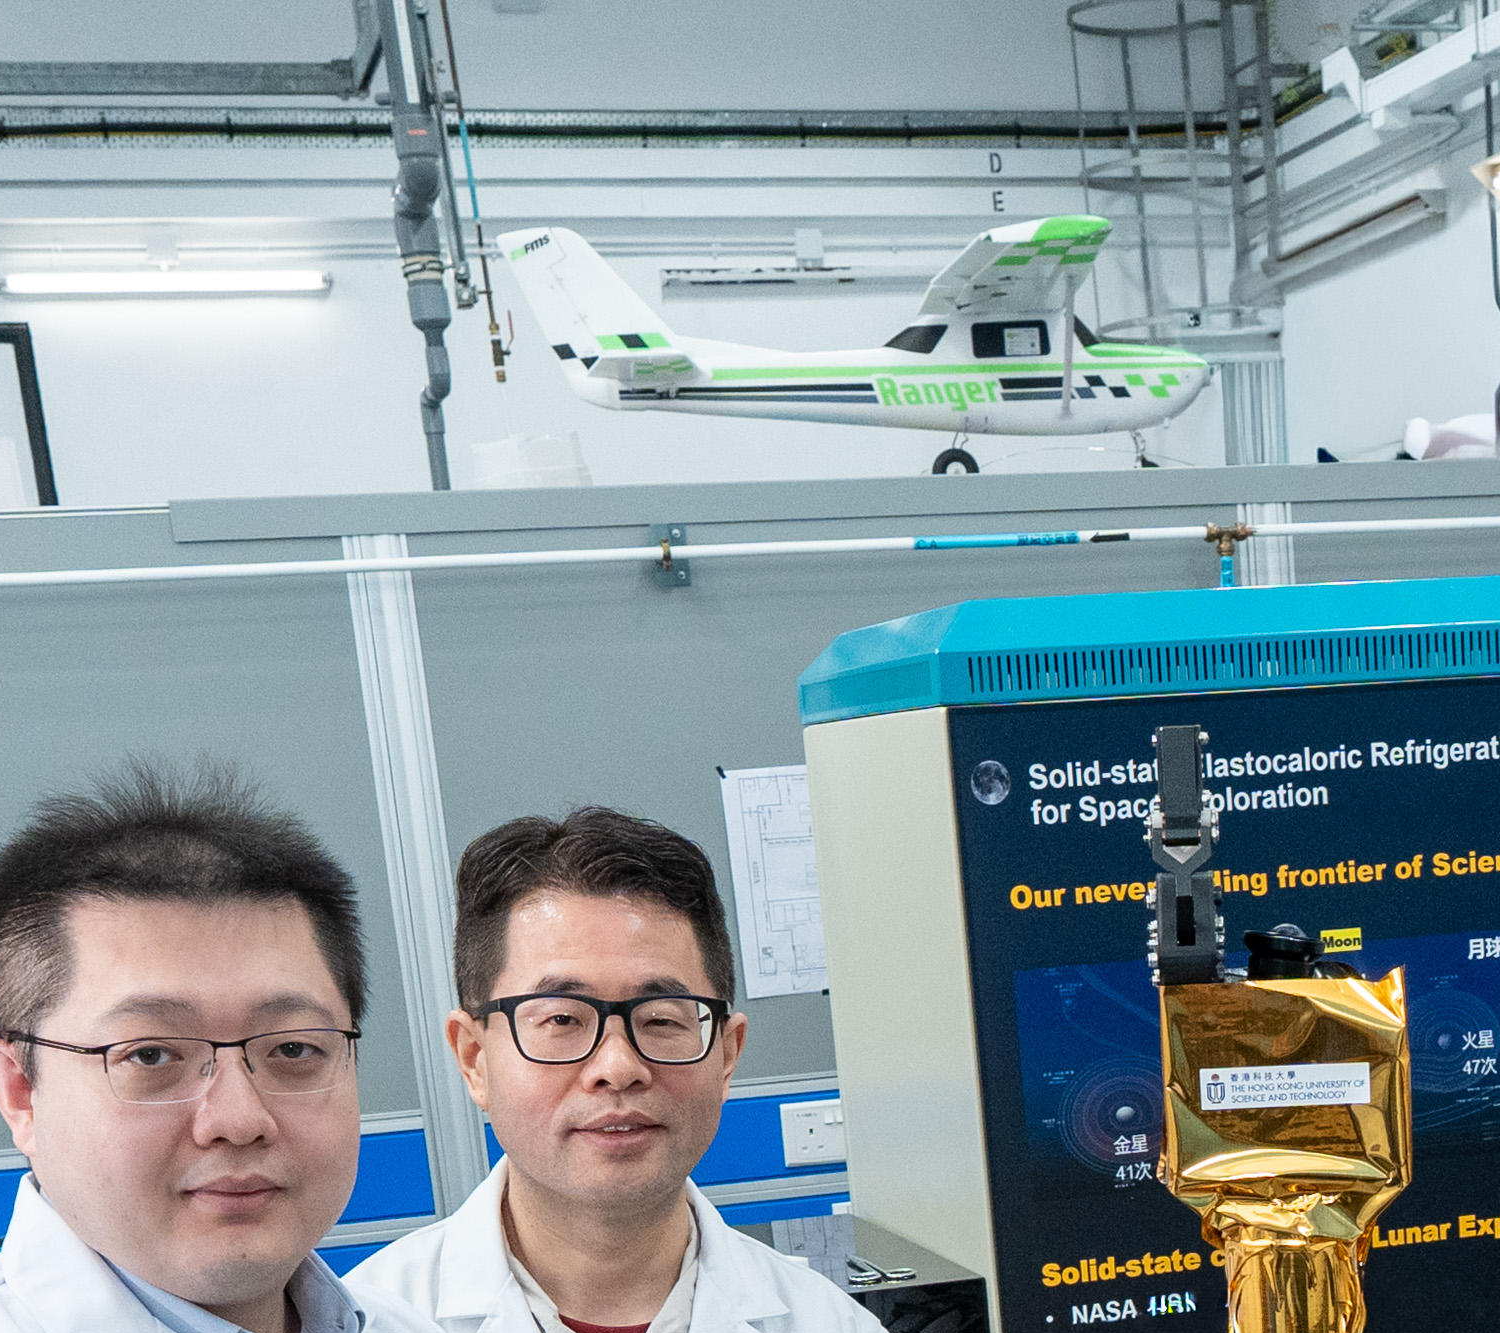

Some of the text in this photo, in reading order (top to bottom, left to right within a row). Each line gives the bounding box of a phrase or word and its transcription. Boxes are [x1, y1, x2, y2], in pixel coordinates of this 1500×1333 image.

[989, 152, 1002, 173] D
[992, 190, 1005, 212] E
[876, 377, 998, 411] Ranger
[1029, 757, 1158, 790] Solid-stat
[1201, 744, 1362, 779] lastocaloric
[1030, 800, 1071, 825] for
[1010, 885, 1066, 909] Our
[1277, 858, 1386, 888] frontier
[1395, 854, 1422, 879] of
[1322, 936, 1362, 948] Moon
[1462, 1030, 1494, 1050] 火星
[1230, 1070, 1296, 1082] 香港科技大學
[1462, 1057, 1497, 1075] 47次
[1231, 1079, 1365, 1093] THE HONG KONG UNIVERSITY OF
[1231, 1090, 1347, 1103] SCIENCE AND TECHNOLOGY
[1113, 1134, 1149, 1155] 金星
[1115, 1161, 1153, 1180] 41次
[1041, 1250, 1201, 1287] Solid-state
[1372, 1219, 1451, 1249] Lunar
[1071, 1299, 1137, 1325] NASA
